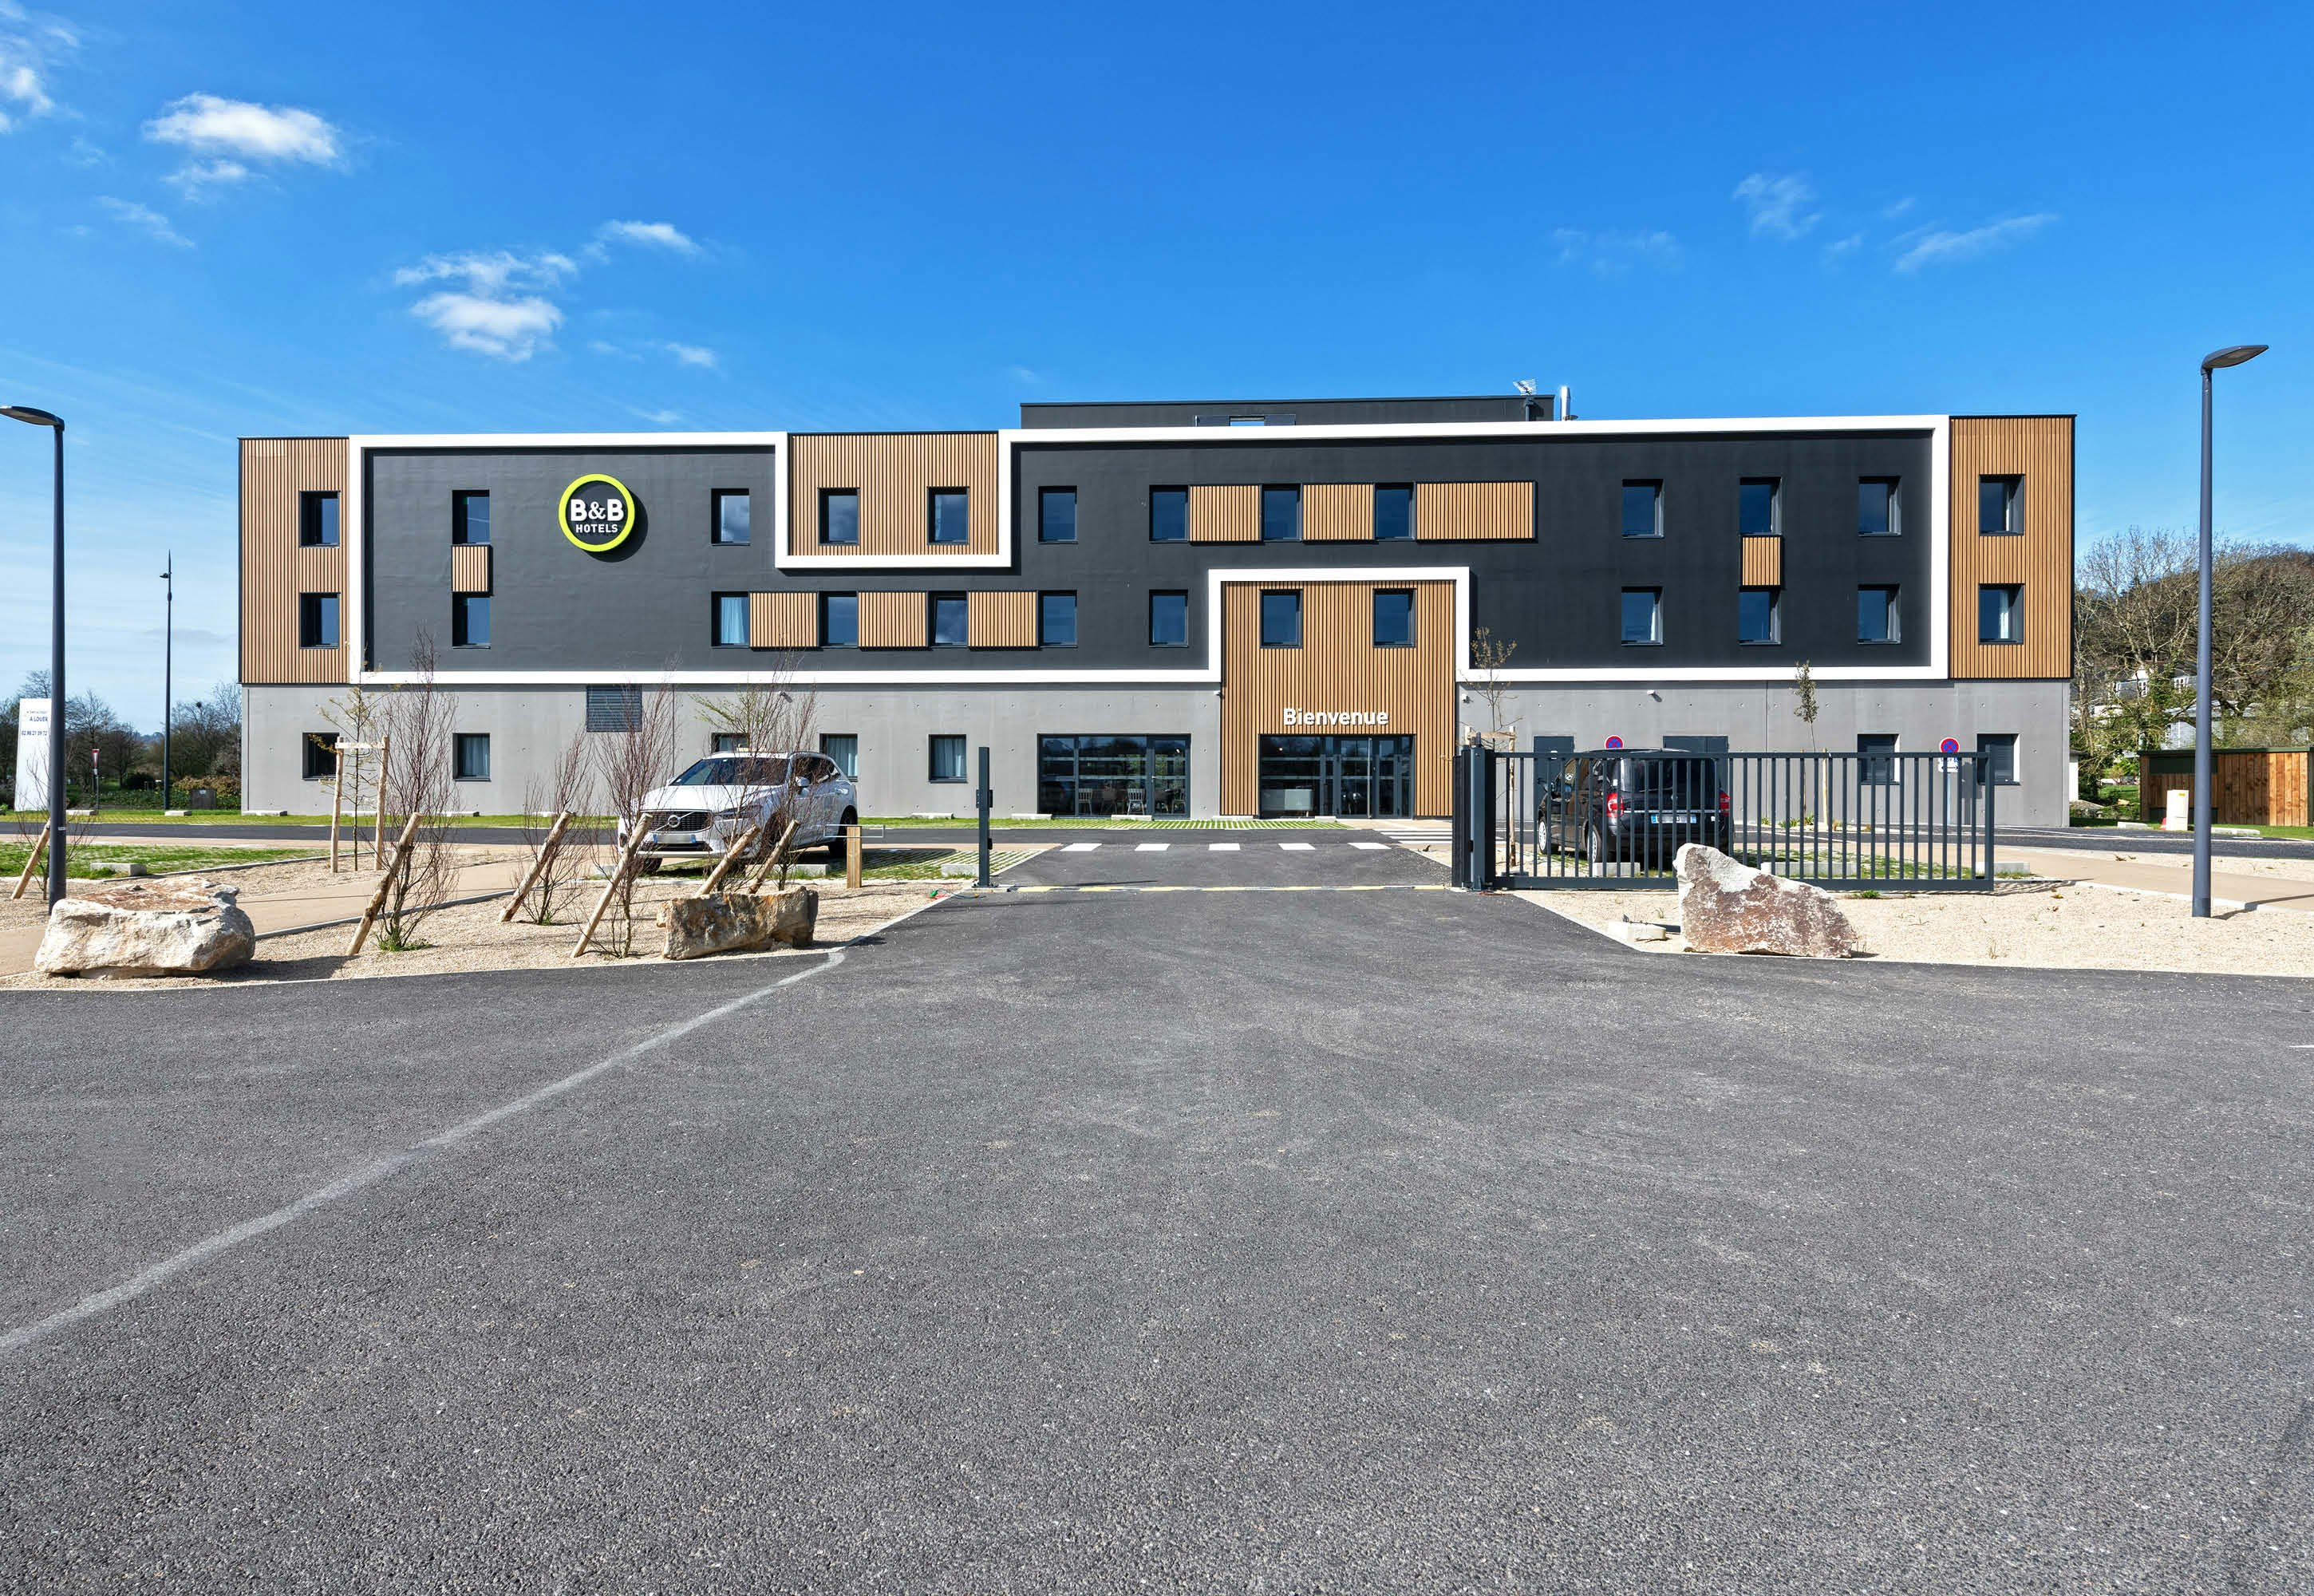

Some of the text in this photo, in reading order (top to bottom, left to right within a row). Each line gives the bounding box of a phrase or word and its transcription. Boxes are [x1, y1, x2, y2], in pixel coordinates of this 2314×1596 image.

[571, 499, 624, 521] B&B
[575, 523, 618, 533] HOTELS
[1283, 708, 1389, 725] Bienvenue
